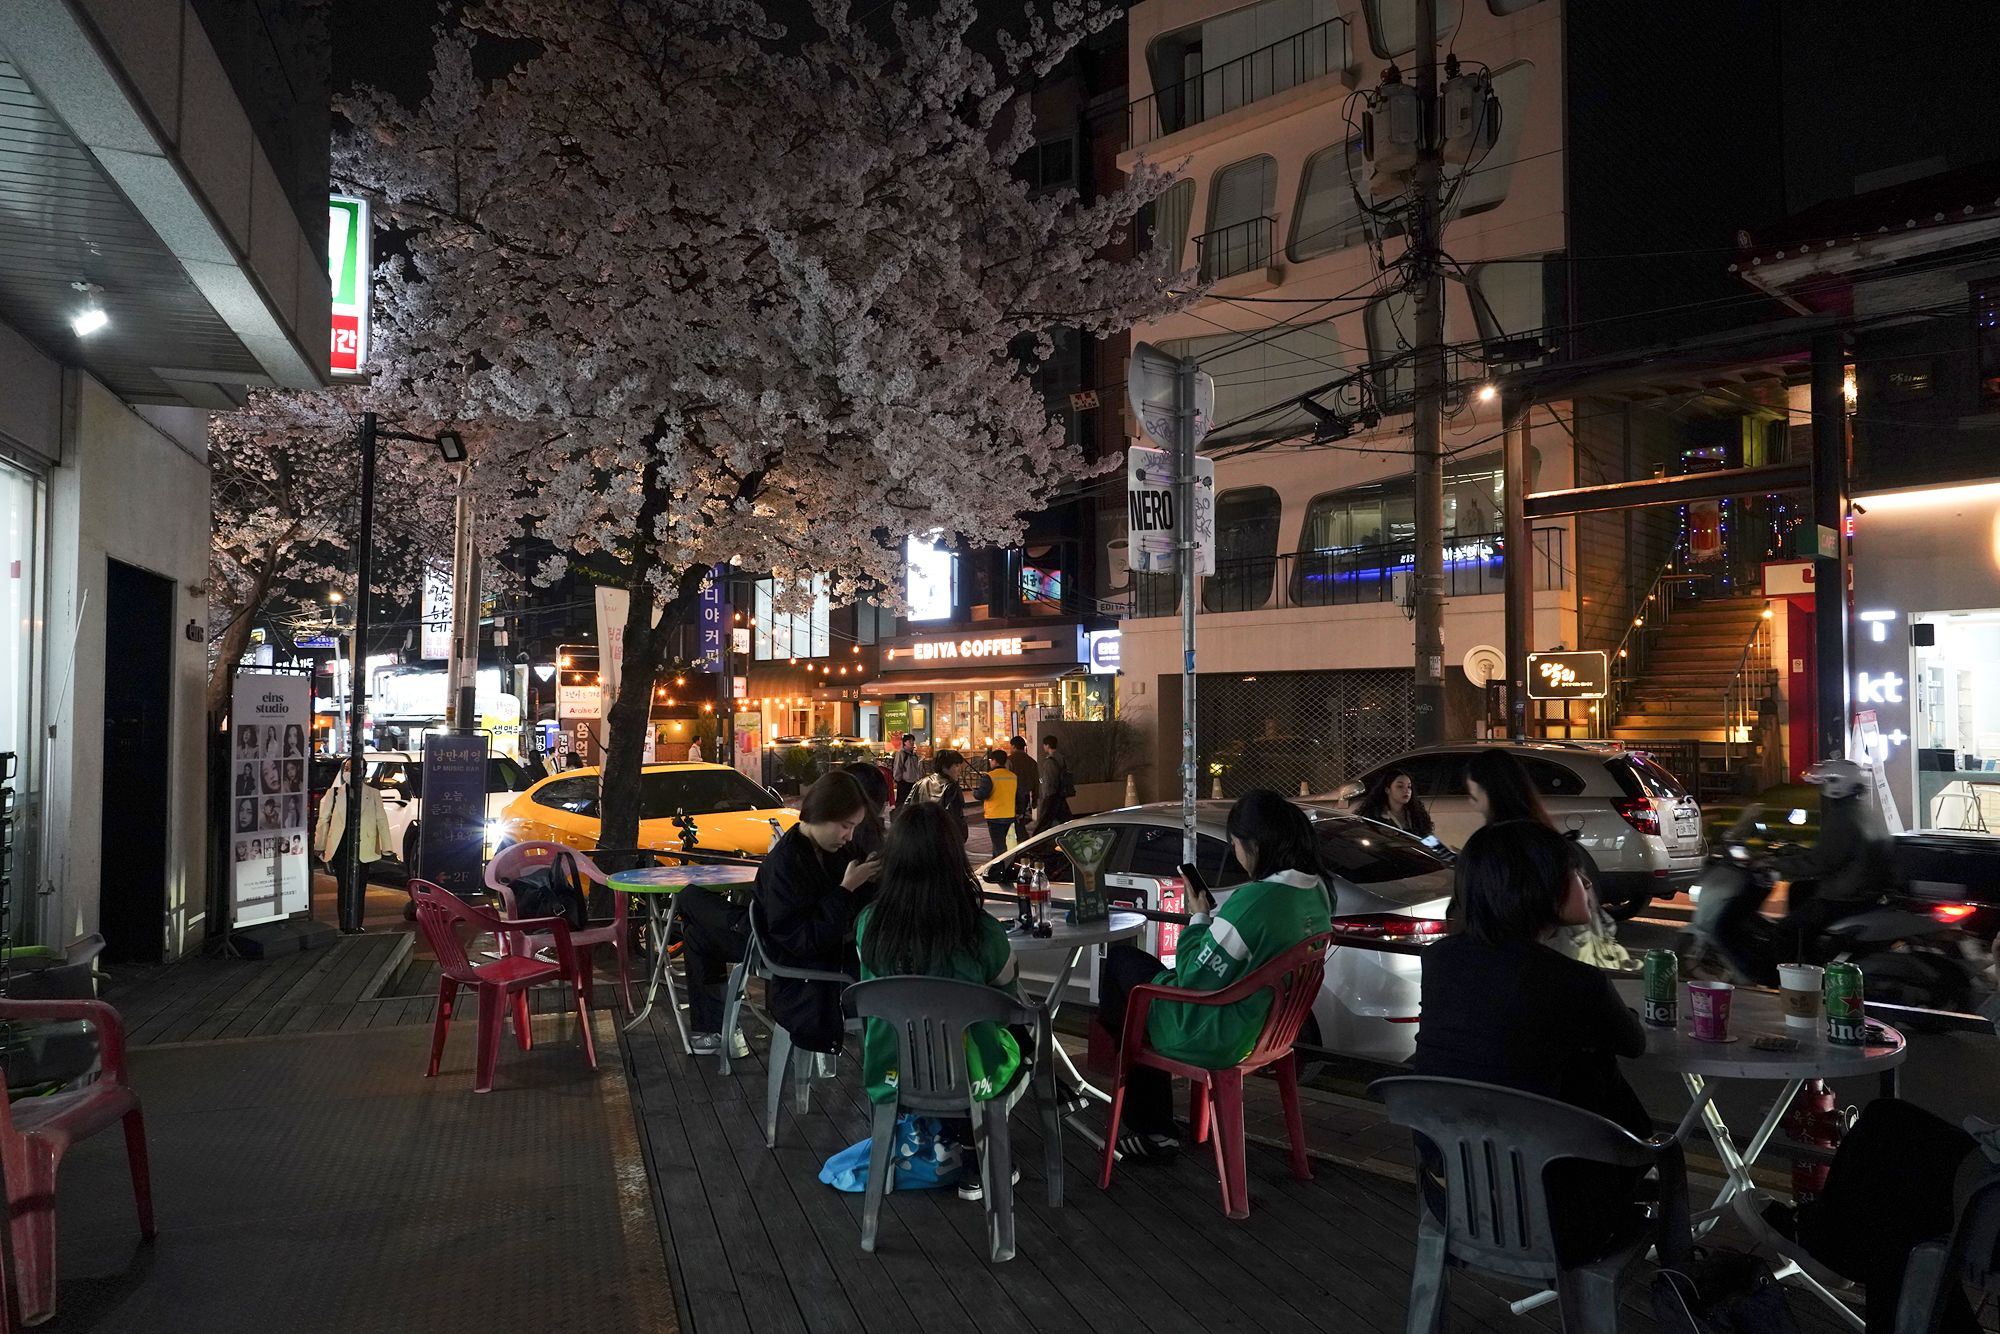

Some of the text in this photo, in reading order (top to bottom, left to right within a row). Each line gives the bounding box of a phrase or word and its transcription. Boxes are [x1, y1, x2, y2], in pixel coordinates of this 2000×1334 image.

[1129, 490, 1174, 531] NERO
[1860, 611, 1896, 641] T
[913, 637, 1022, 660] EDIYA COFFEE
[262, 692, 284, 702] eins
[1858, 672, 1903, 703] kt
[256, 703, 289, 713] studio
[453, 871, 471, 882] 2F
